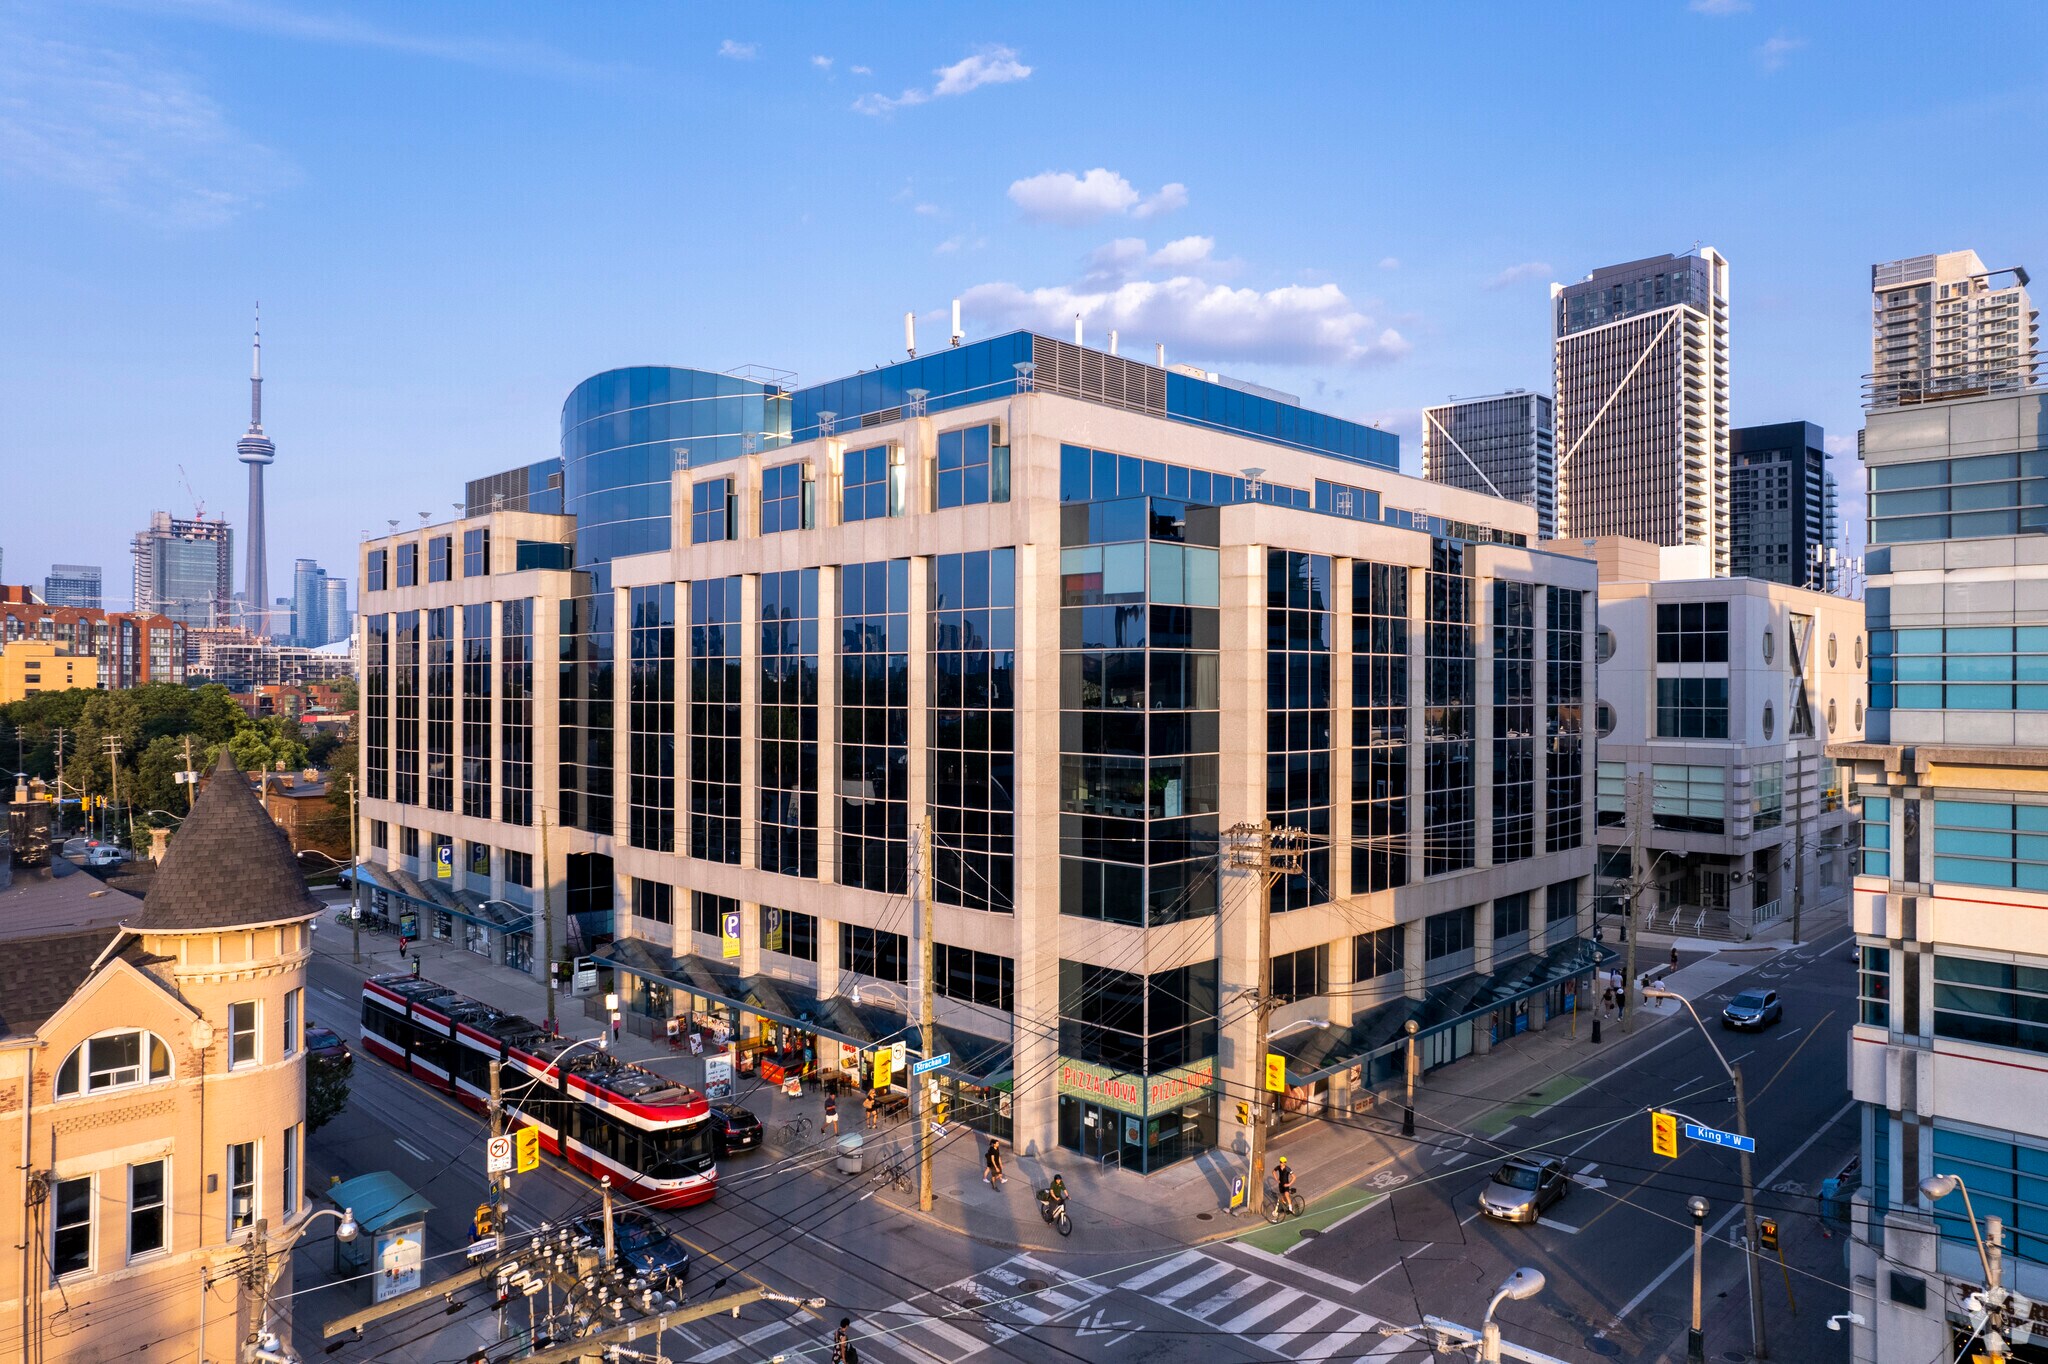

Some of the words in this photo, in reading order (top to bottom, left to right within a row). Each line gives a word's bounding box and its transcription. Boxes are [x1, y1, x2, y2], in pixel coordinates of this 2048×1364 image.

[442, 848, 450, 860] P
[728, 915, 738, 933] P
[916, 1057, 942, 1072] Strachan
[1064, 1066, 1101, 1095] PIZZA
[1103, 1079, 1137, 1105] NOVA
[1151, 1077, 1184, 1105] PIZZA
[1698, 1127, 1722, 1143] King
[1733, 1135, 1742, 1146] W
